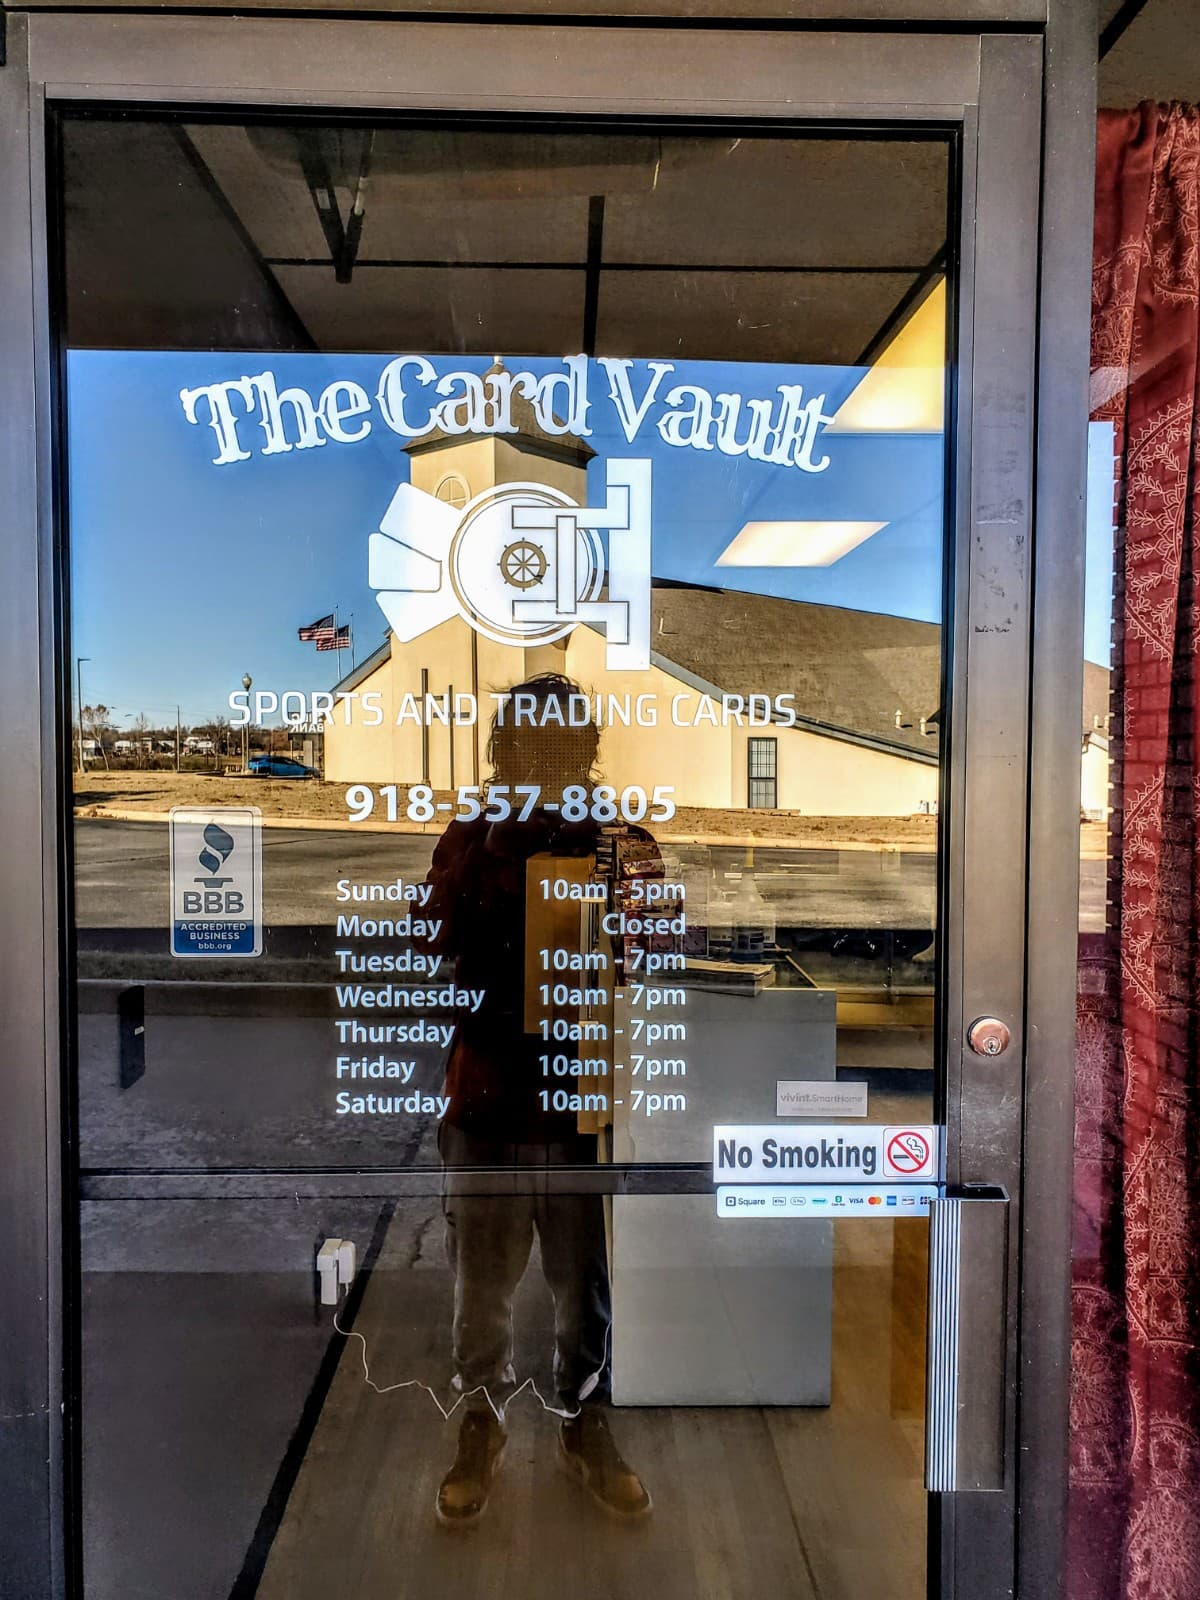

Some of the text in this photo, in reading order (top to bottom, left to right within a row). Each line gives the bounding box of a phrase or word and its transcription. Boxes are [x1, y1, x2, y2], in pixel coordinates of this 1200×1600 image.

[178, 353, 835, 473] The Card Vault
[228, 691, 796, 728] SPORTS AND TRADING CARDS
[345, 785, 676, 822] 918-557-8805
[183, 891, 245, 914] BBB
[335, 879, 433, 906] Sunday
[538, 879, 607, 900] 10am
[630, 879, 686, 906] 5pm
[181, 923, 247, 931] ACCREDITED
[190, 932, 240, 940] BUSINESS
[335, 913, 686, 942] Monday Closed
[198, 942, 232, 950] bbb.org
[335, 949, 442, 977] Tuesday
[538, 949, 607, 970] 10am
[630, 949, 686, 975] 7pm
[335, 984, 486, 1012] Wednesday
[538, 984, 607, 1006] 10am
[630, 984, 686, 1011] 7pm
[335, 1020, 455, 1048] Thursday
[538, 1020, 607, 1041] 10am
[630, 1020, 686, 1046] 7pm
[335, 1055, 416, 1083] Friday
[538, 1055, 607, 1076] 10am
[630, 1055, 686, 1081] 7pm
[335, 1090, 451, 1118] Saturday
[538, 1090, 607, 1111] 10am
[630, 1090, 686, 1116] 7pm
[718, 1138, 877, 1176] No Smoking
[738, 1198, 766, 1207] Square
